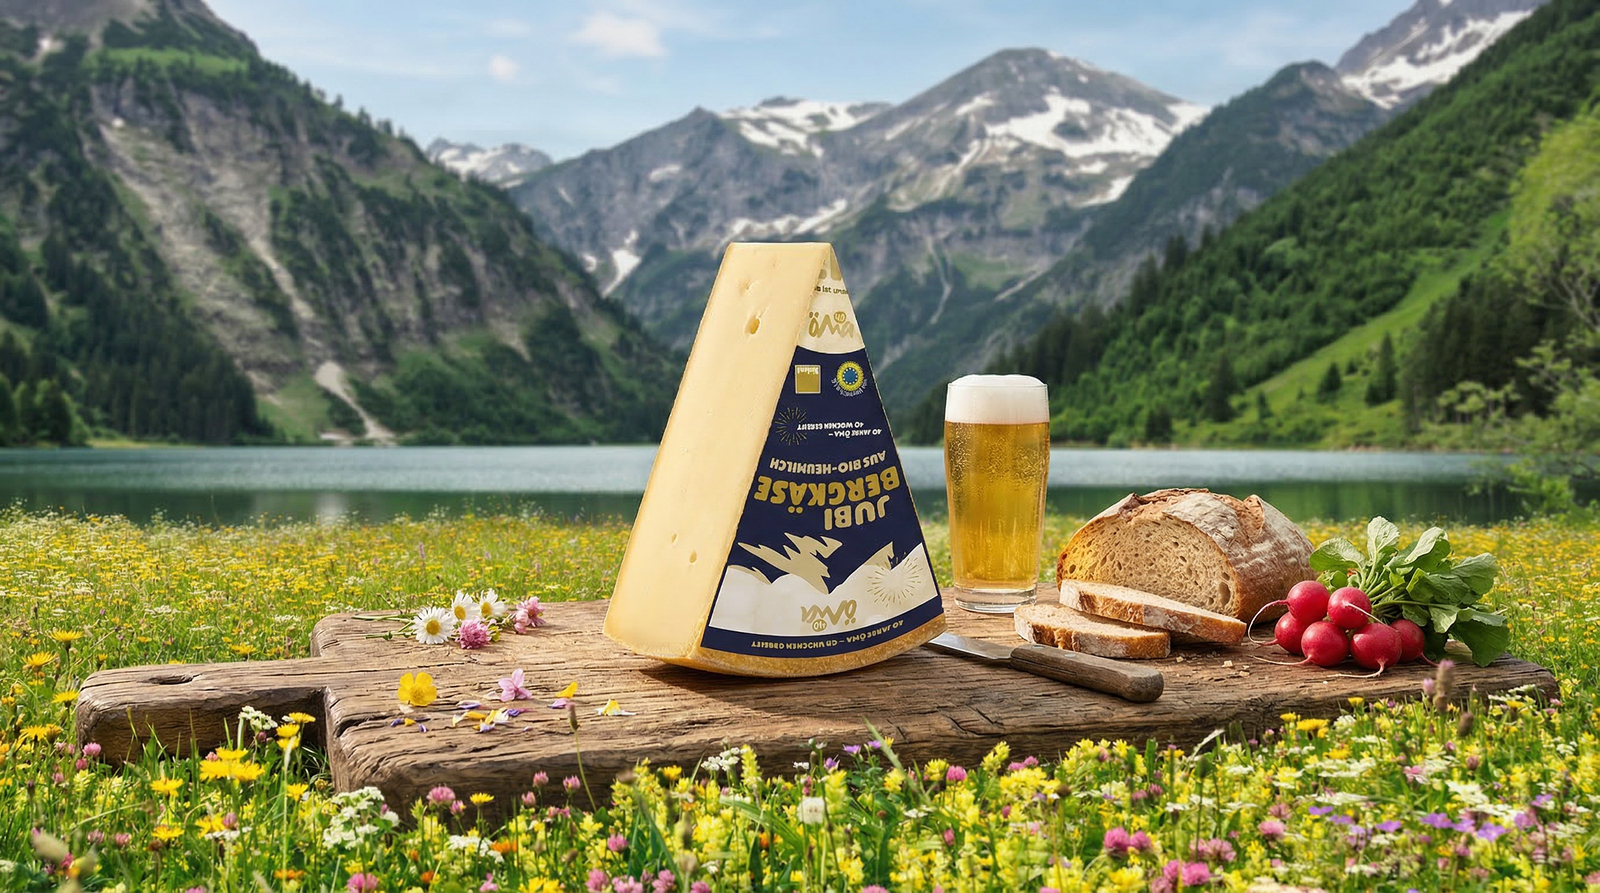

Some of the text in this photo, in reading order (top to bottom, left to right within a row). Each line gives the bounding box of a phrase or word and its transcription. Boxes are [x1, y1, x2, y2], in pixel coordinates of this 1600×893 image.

[854, 421, 865, 429] 40
[871, 428, 882, 436] 40
[769, 450, 886, 475] AUS BIO-HEUMILCH
[753, 465, 901, 514] BERGKÄSE
[824, 494, 890, 531] JUBI
